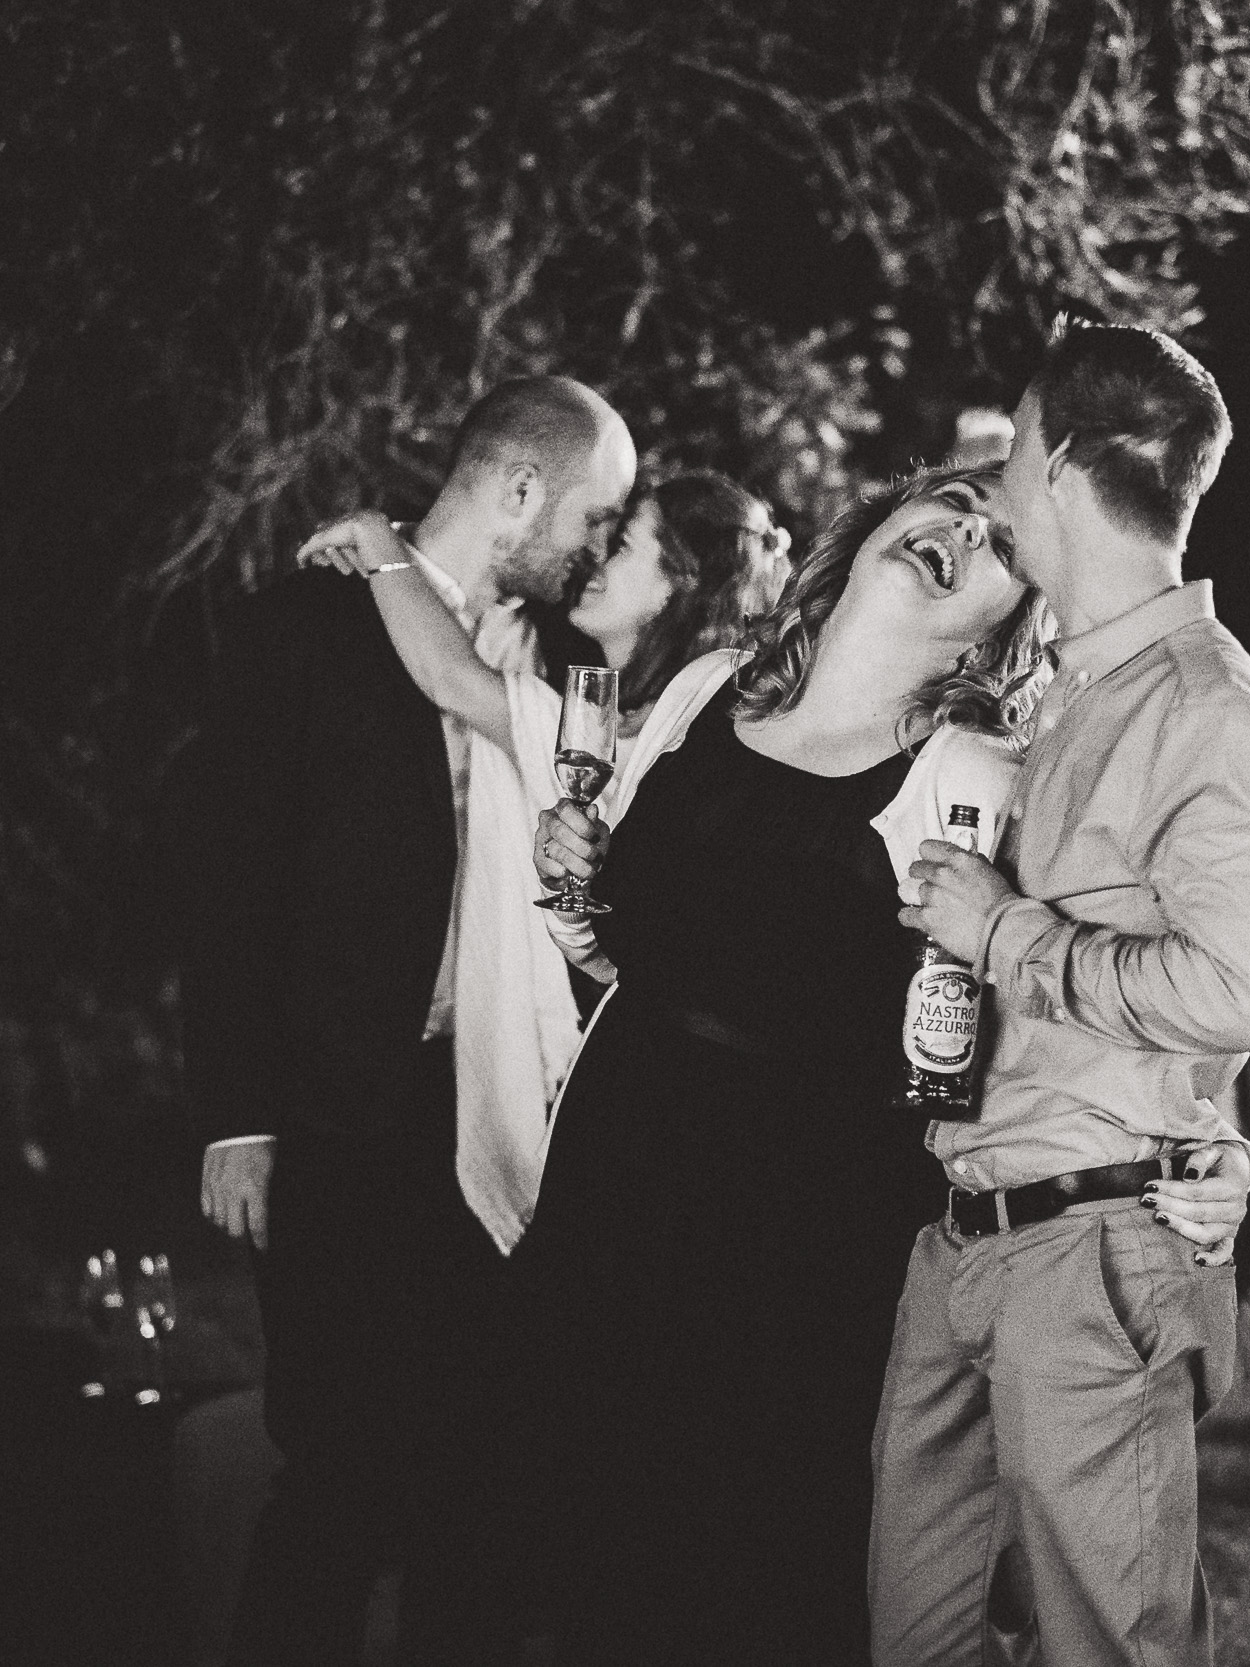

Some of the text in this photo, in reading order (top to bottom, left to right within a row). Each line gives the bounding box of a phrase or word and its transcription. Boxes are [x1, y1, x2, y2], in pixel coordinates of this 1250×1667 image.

[919, 1001, 975, 1021] NASTRO
[912, 1016, 976, 1035] AZZURRO
[928, 1055, 961, 1064] ITALIANA
